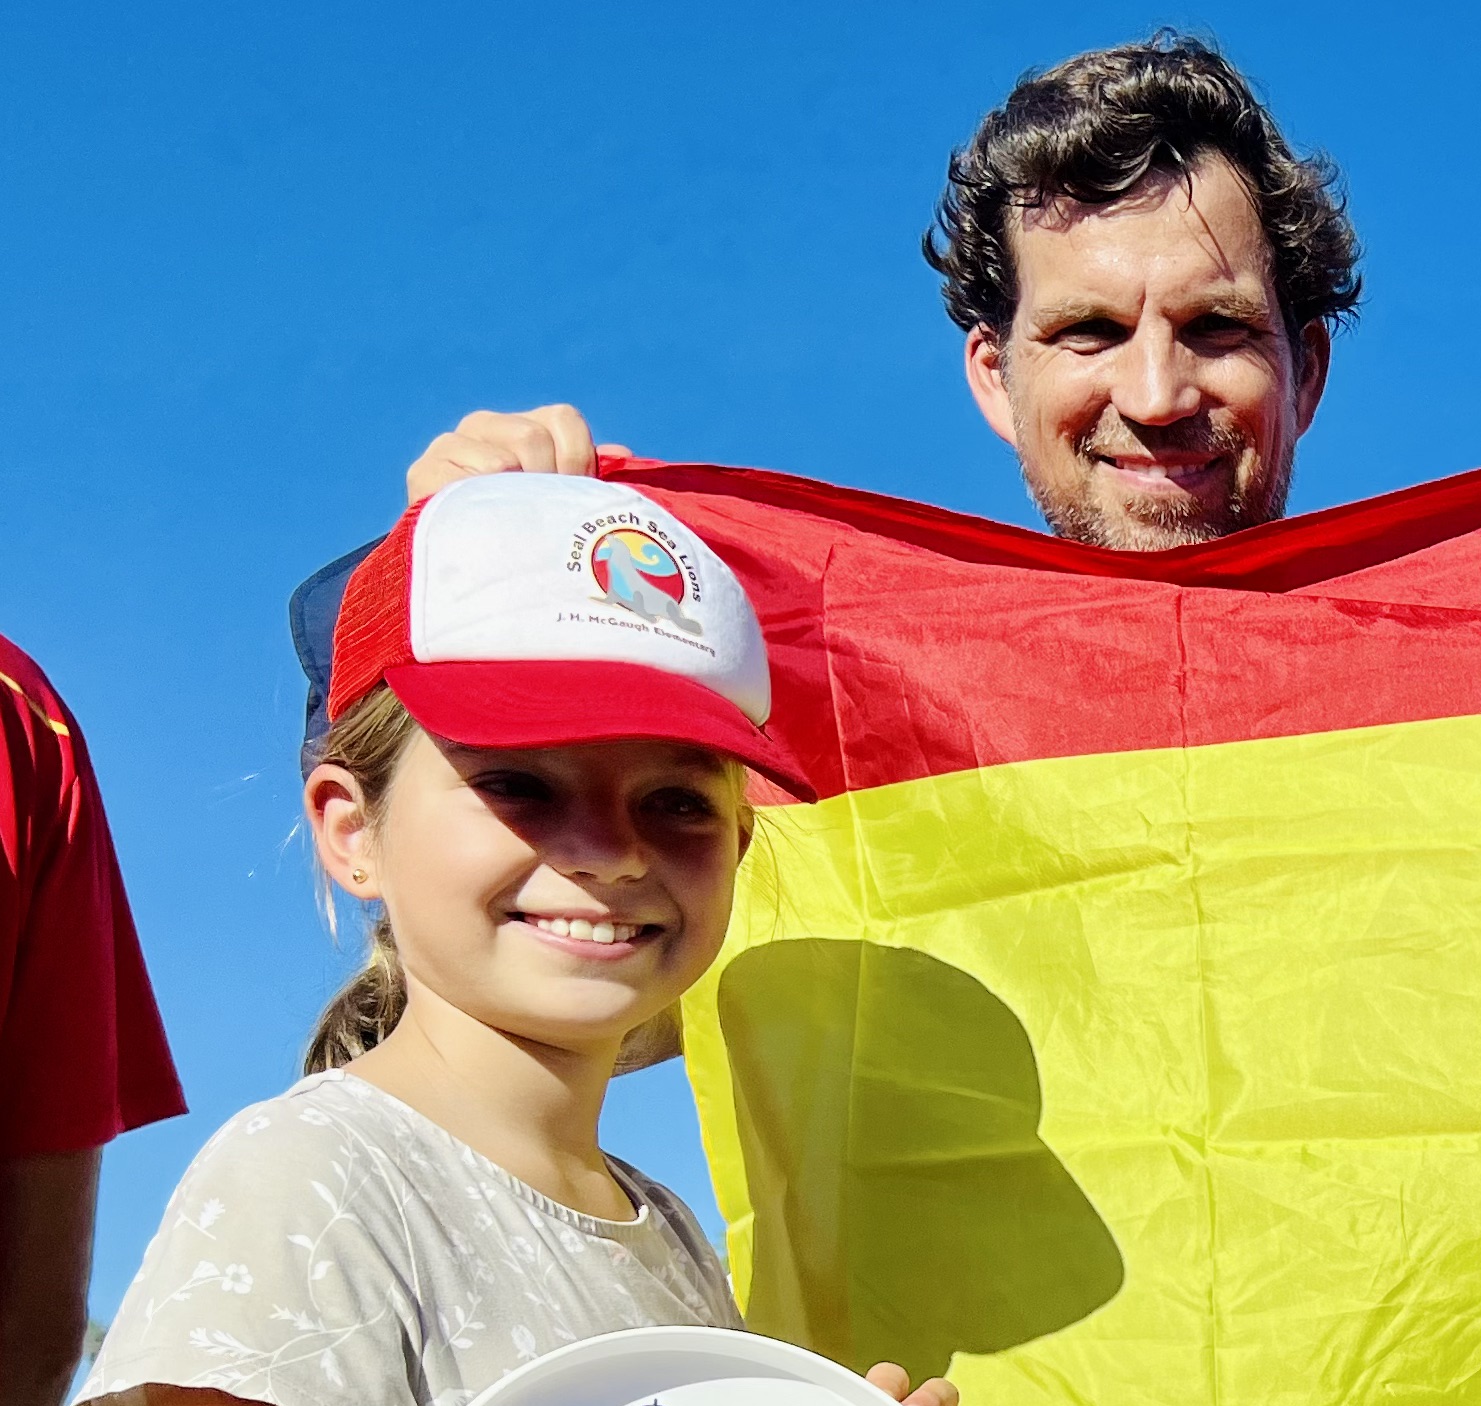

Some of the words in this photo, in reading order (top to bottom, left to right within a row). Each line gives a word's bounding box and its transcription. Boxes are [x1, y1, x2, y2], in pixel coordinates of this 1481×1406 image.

[567, 534, 588, 573] Seal
[581, 512, 640, 534] Beach
[647, 520, 677, 550] Sea
[679, 554, 702, 603] Lions
[588, 614, 650, 633] McGaugh
[653, 626, 716, 658] Elementary
